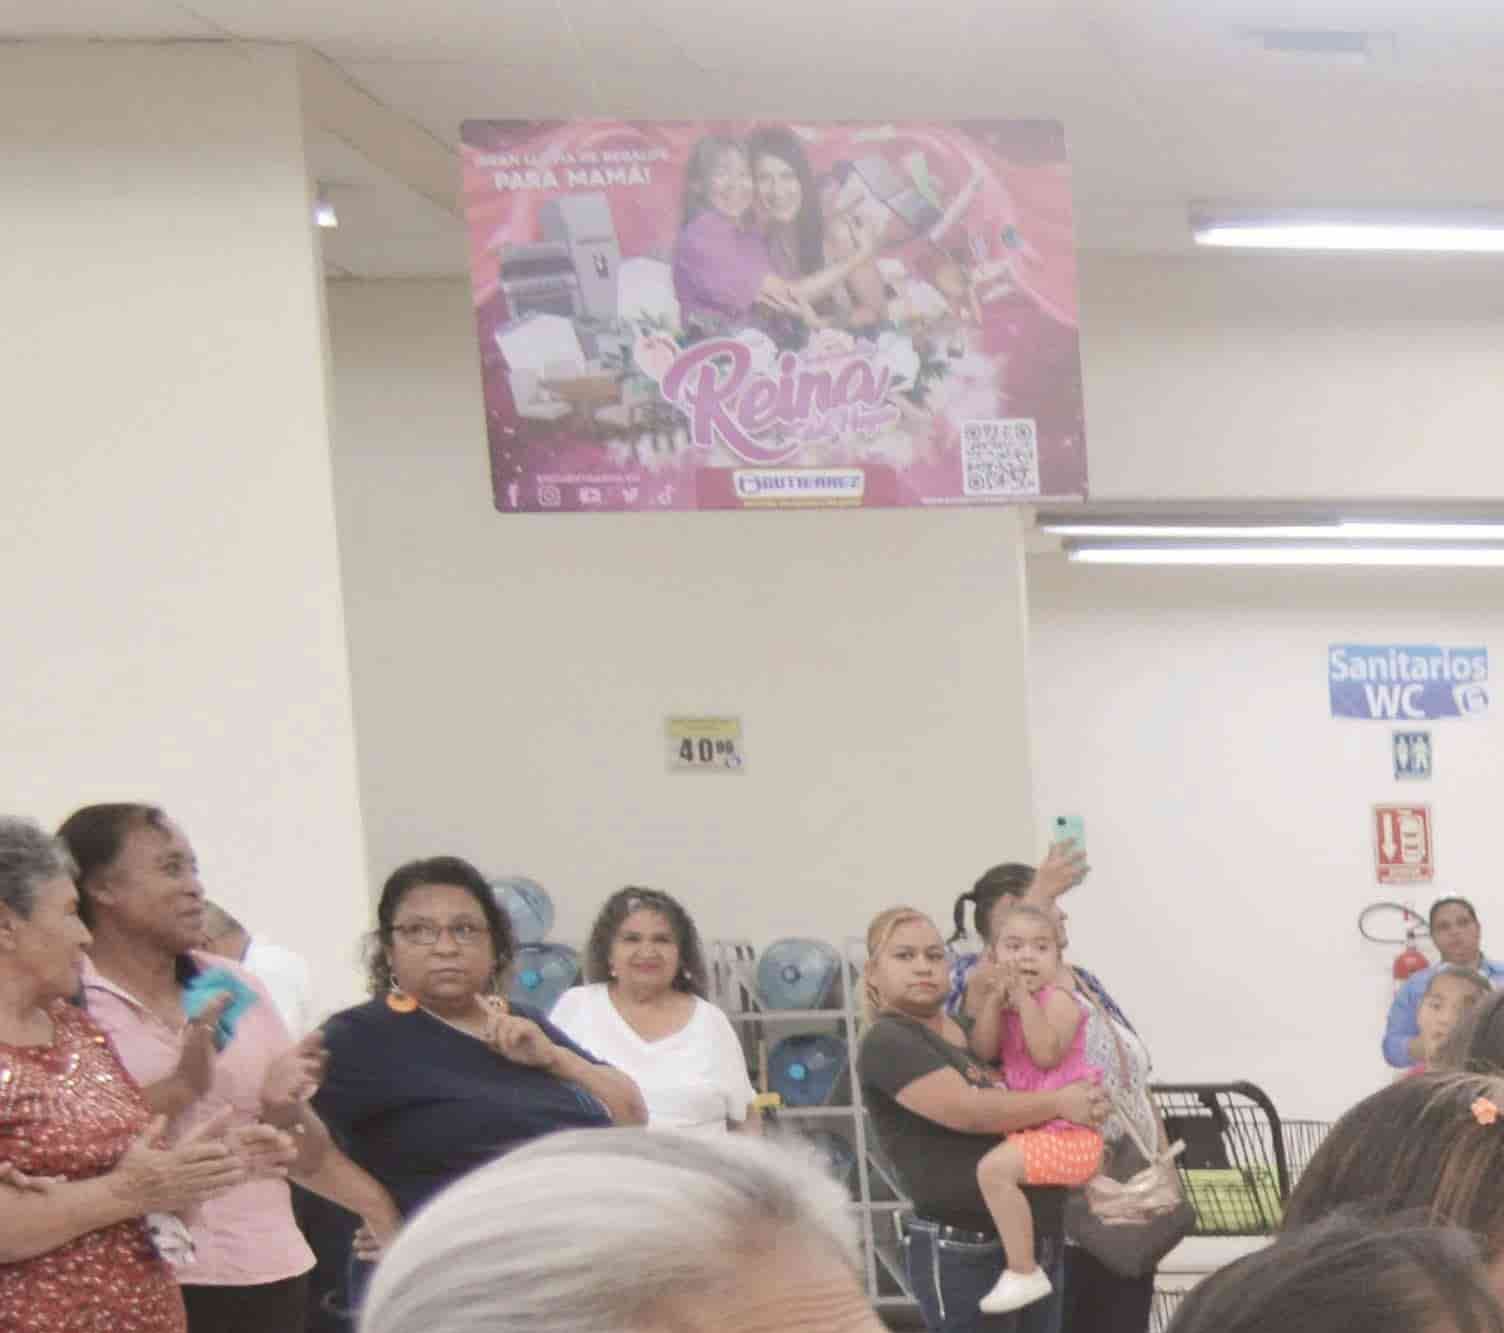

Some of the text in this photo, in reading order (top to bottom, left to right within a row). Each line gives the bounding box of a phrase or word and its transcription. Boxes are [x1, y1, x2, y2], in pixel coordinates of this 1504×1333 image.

[660, 337, 890, 464] Reina
[1330, 650, 1488, 682] Sanitarios
[1364, 684, 1426, 718] WC
